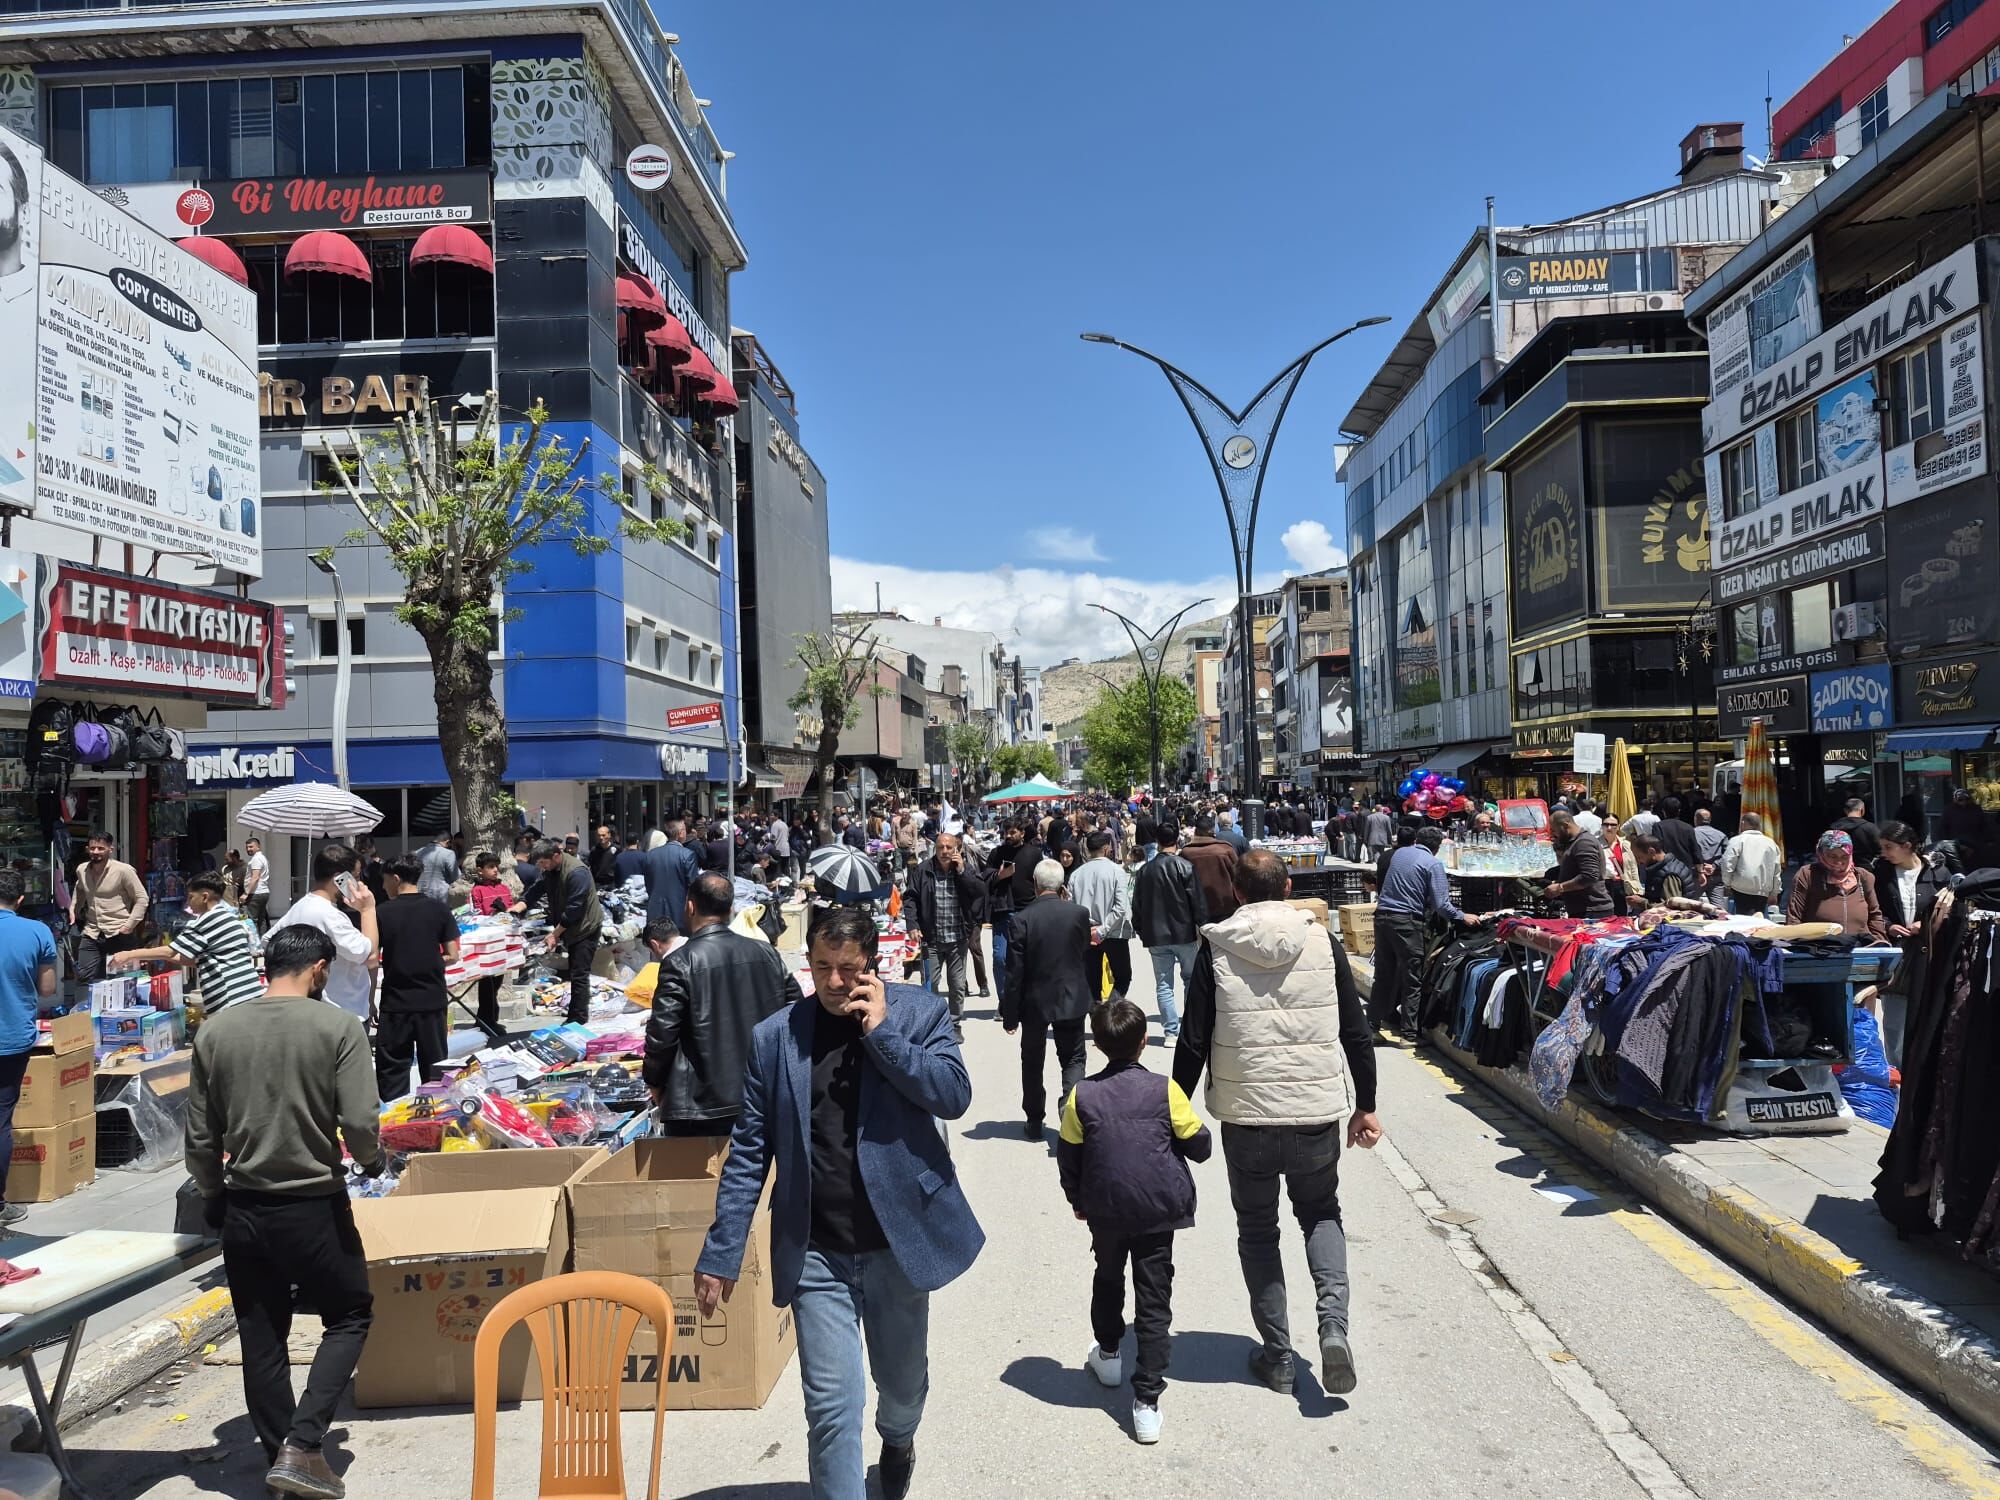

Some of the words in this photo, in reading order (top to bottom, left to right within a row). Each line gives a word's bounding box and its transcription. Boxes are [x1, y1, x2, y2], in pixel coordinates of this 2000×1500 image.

[231, 179, 274, 215] Bi
[283, 176, 446, 224] Meyhane
[368, 209, 443, 223] Restaurant&
[447, 207, 468, 218] Bar
[1529, 257, 1608, 283] FARADAY
[117, 272, 150, 304] COPY
[152, 292, 197, 330] CENTER
[1529, 284, 1544, 295] ETÜT
[1545, 282, 1572, 294] MERKEZİ
[1572, 282, 1589, 293] KİTAP
[1593, 283, 1609, 292] KAFE
[1739, 352, 1824, 426] ÖZALP
[1833, 270, 1958, 376] EMLAK
[196, 367, 206, 380] VE
[321, 374, 424, 415] BAR
[96, 471, 120, 496] VARAN
[38, 486, 55, 500] SICAK
[106, 505, 120, 518] KART
[1719, 513, 1784, 564] ÖZALP
[1790, 473, 1877, 540] EMLAK
[1720, 573, 1744, 599] ÖZER
[1745, 561, 1779, 592] İNŞAAT
[1780, 559, 1791, 580] &
[1792, 532, 1871, 576] GAYRİMENKUL
[70, 579, 130, 626] EFE
[139, 593, 263, 649] KIRTASİYE
[69, 646, 101, 667] Ozalit
[110, 652, 136, 674] Kaşe
[145, 656, 174, 675] Plaket
[182, 659, 206, 681] Kitap
[214, 665, 249, 685] Fotokopi
[1722, 665, 1756, 680] EMLAK
[1759, 664, 1768, 674] &
[1770, 657, 1803, 672] SATIŞ
[1726, 687, 1790, 713] SADIKSOYLAR
[1812, 675, 1889, 718] SADIKSOY
[1815, 715, 1852, 732] ALTIN
[1784, 1095, 1836, 1118] TEKSTİL
[403, 1266, 526, 1292] KETSAN
